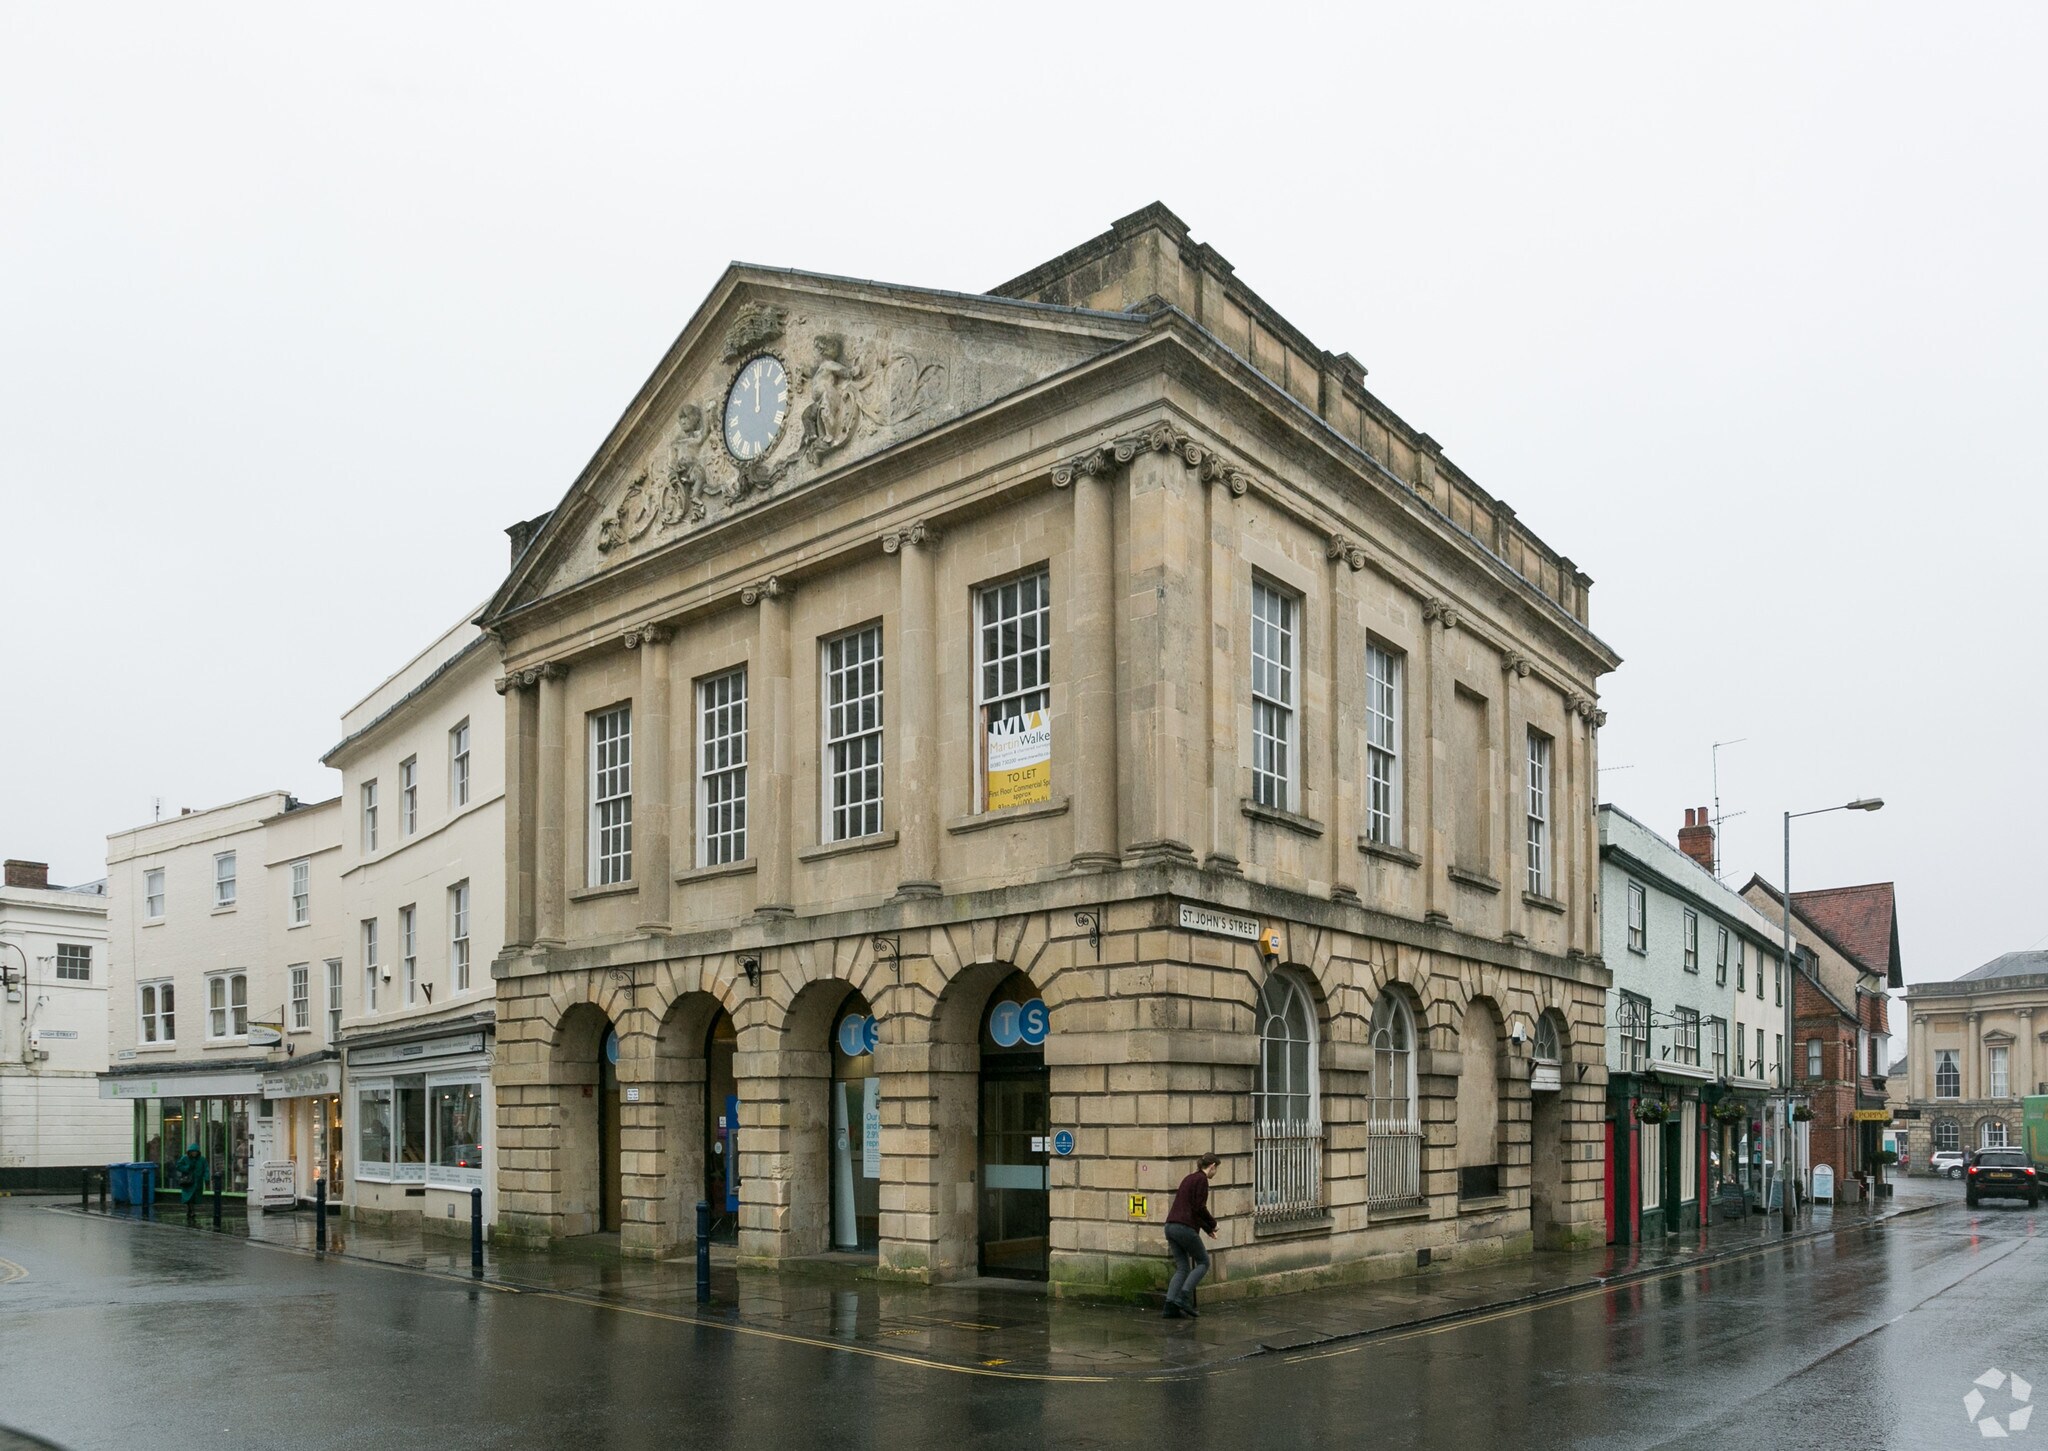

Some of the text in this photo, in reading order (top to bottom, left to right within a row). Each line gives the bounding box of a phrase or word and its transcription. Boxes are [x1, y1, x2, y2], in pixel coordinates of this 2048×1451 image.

[1007, 768, 1037, 783] TO LET
[1000, 787, 1012, 796] Floor
[1013, 781, 1042, 792] Commercial
[1013, 791, 1031, 800] approx
[1229, 918, 1257, 935] STREET
[866, 1112, 877, 1121] Our
[1131, 1196, 1145, 1214] H
